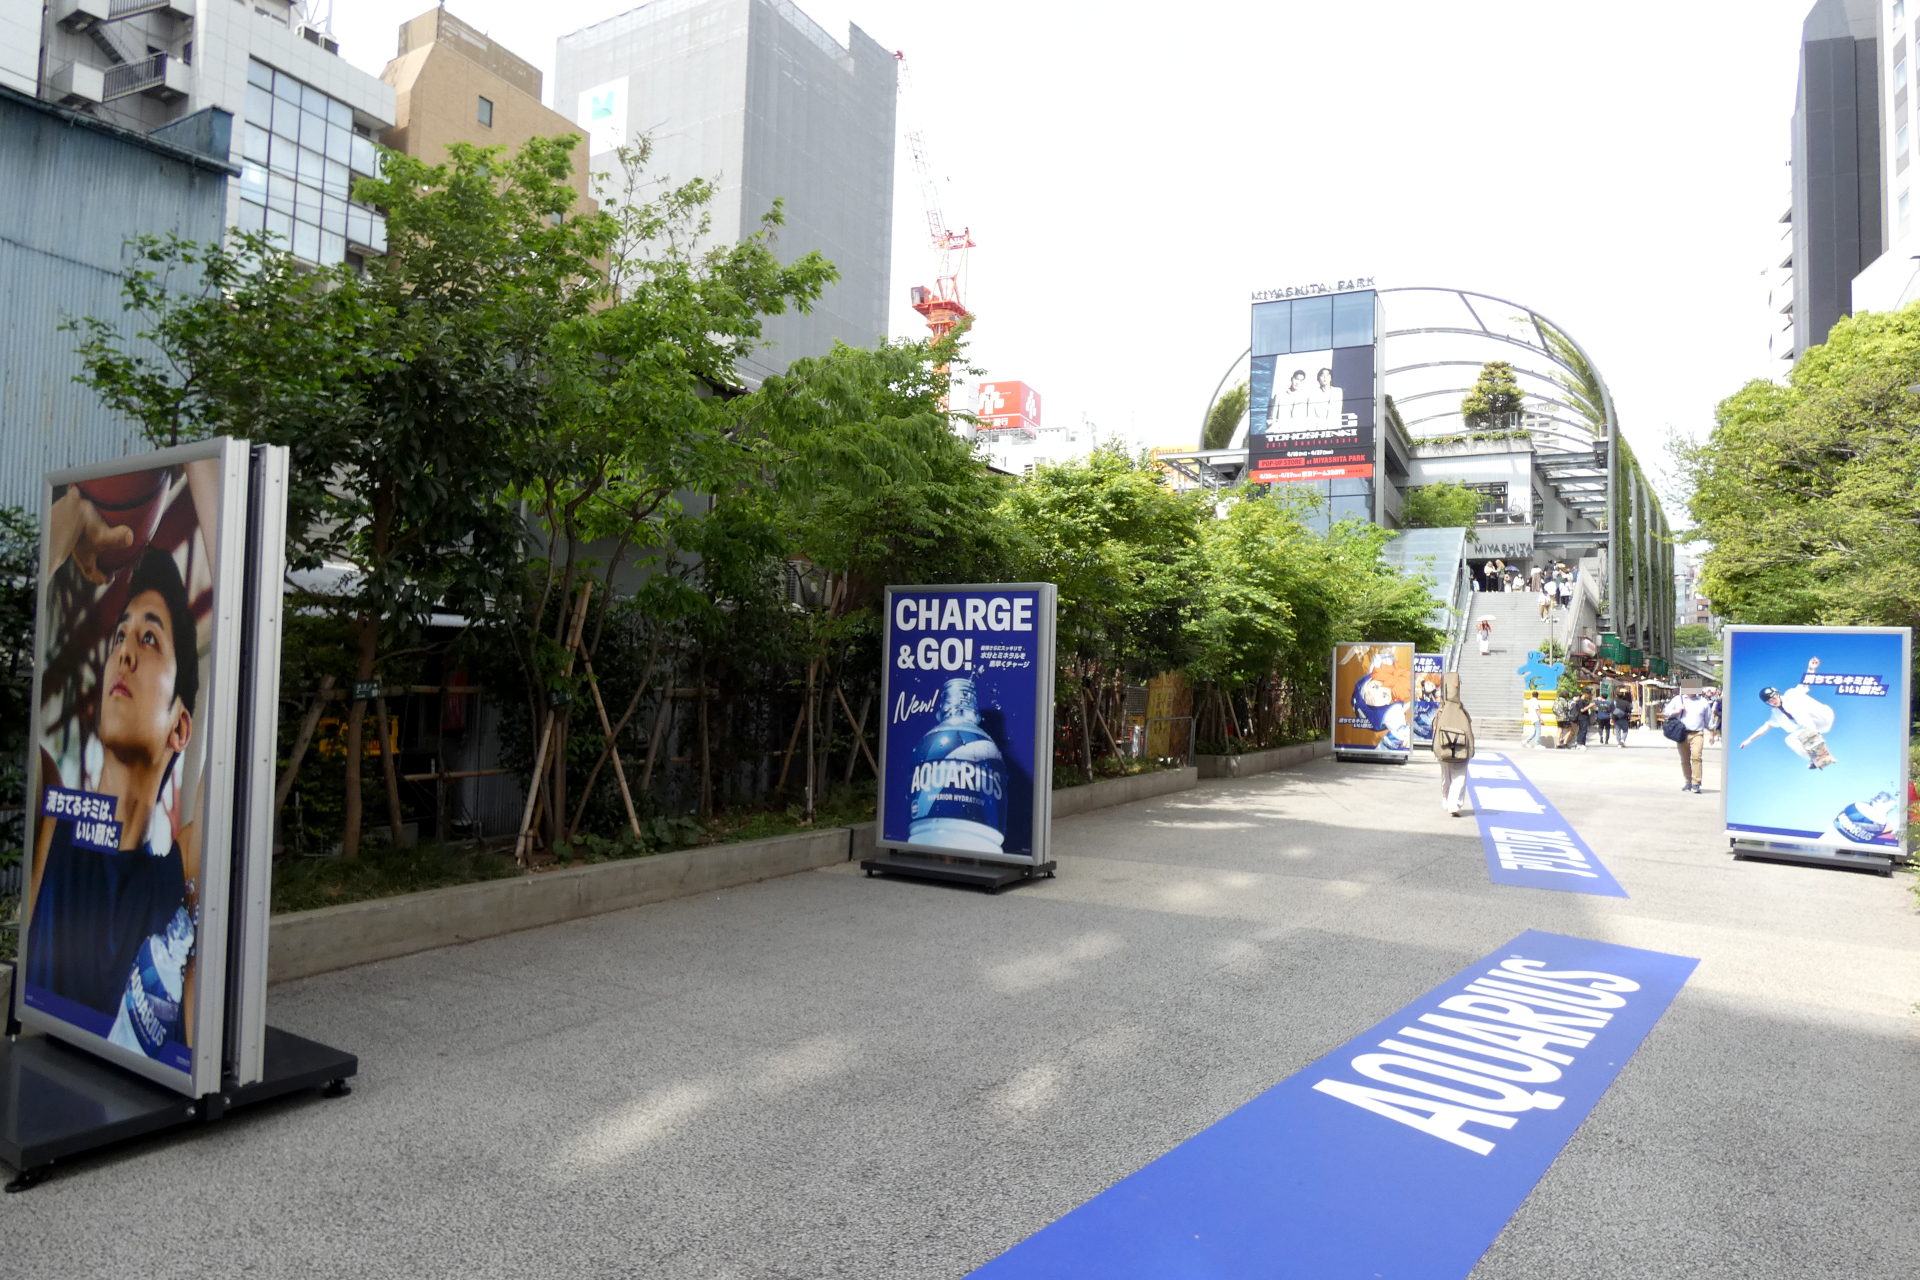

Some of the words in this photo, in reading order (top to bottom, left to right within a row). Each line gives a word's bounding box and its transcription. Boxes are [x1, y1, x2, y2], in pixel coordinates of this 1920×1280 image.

[1252, 282, 1328, 300] MIYASHITA
[1338, 276, 1375, 291] PARK
[1265, 429, 1358, 442] TOHOSHINKI
[1313, 456, 1347, 464] MIYASHITA
[1348, 454, 1366, 462] PARK
[1474, 543, 1533, 555] MIYASHITA
[895, 597, 1033, 632] CHARGE
[896, 637, 974, 671] &GO!
[980, 651, 1027, 660] 水分とミネラルを
[1803, 674, 1878, 686] 満ちてるキミは、
[1838, 685, 1886, 696] いい顔だ。
[893, 689, 940, 724] New!
[910, 760, 1003, 801] AQUARIUS
[46, 790, 113, 823] 満ちてるキミは、
[75, 820, 119, 849] いい顔だ。
[1311, 958, 1641, 1157] AQUARIUS
